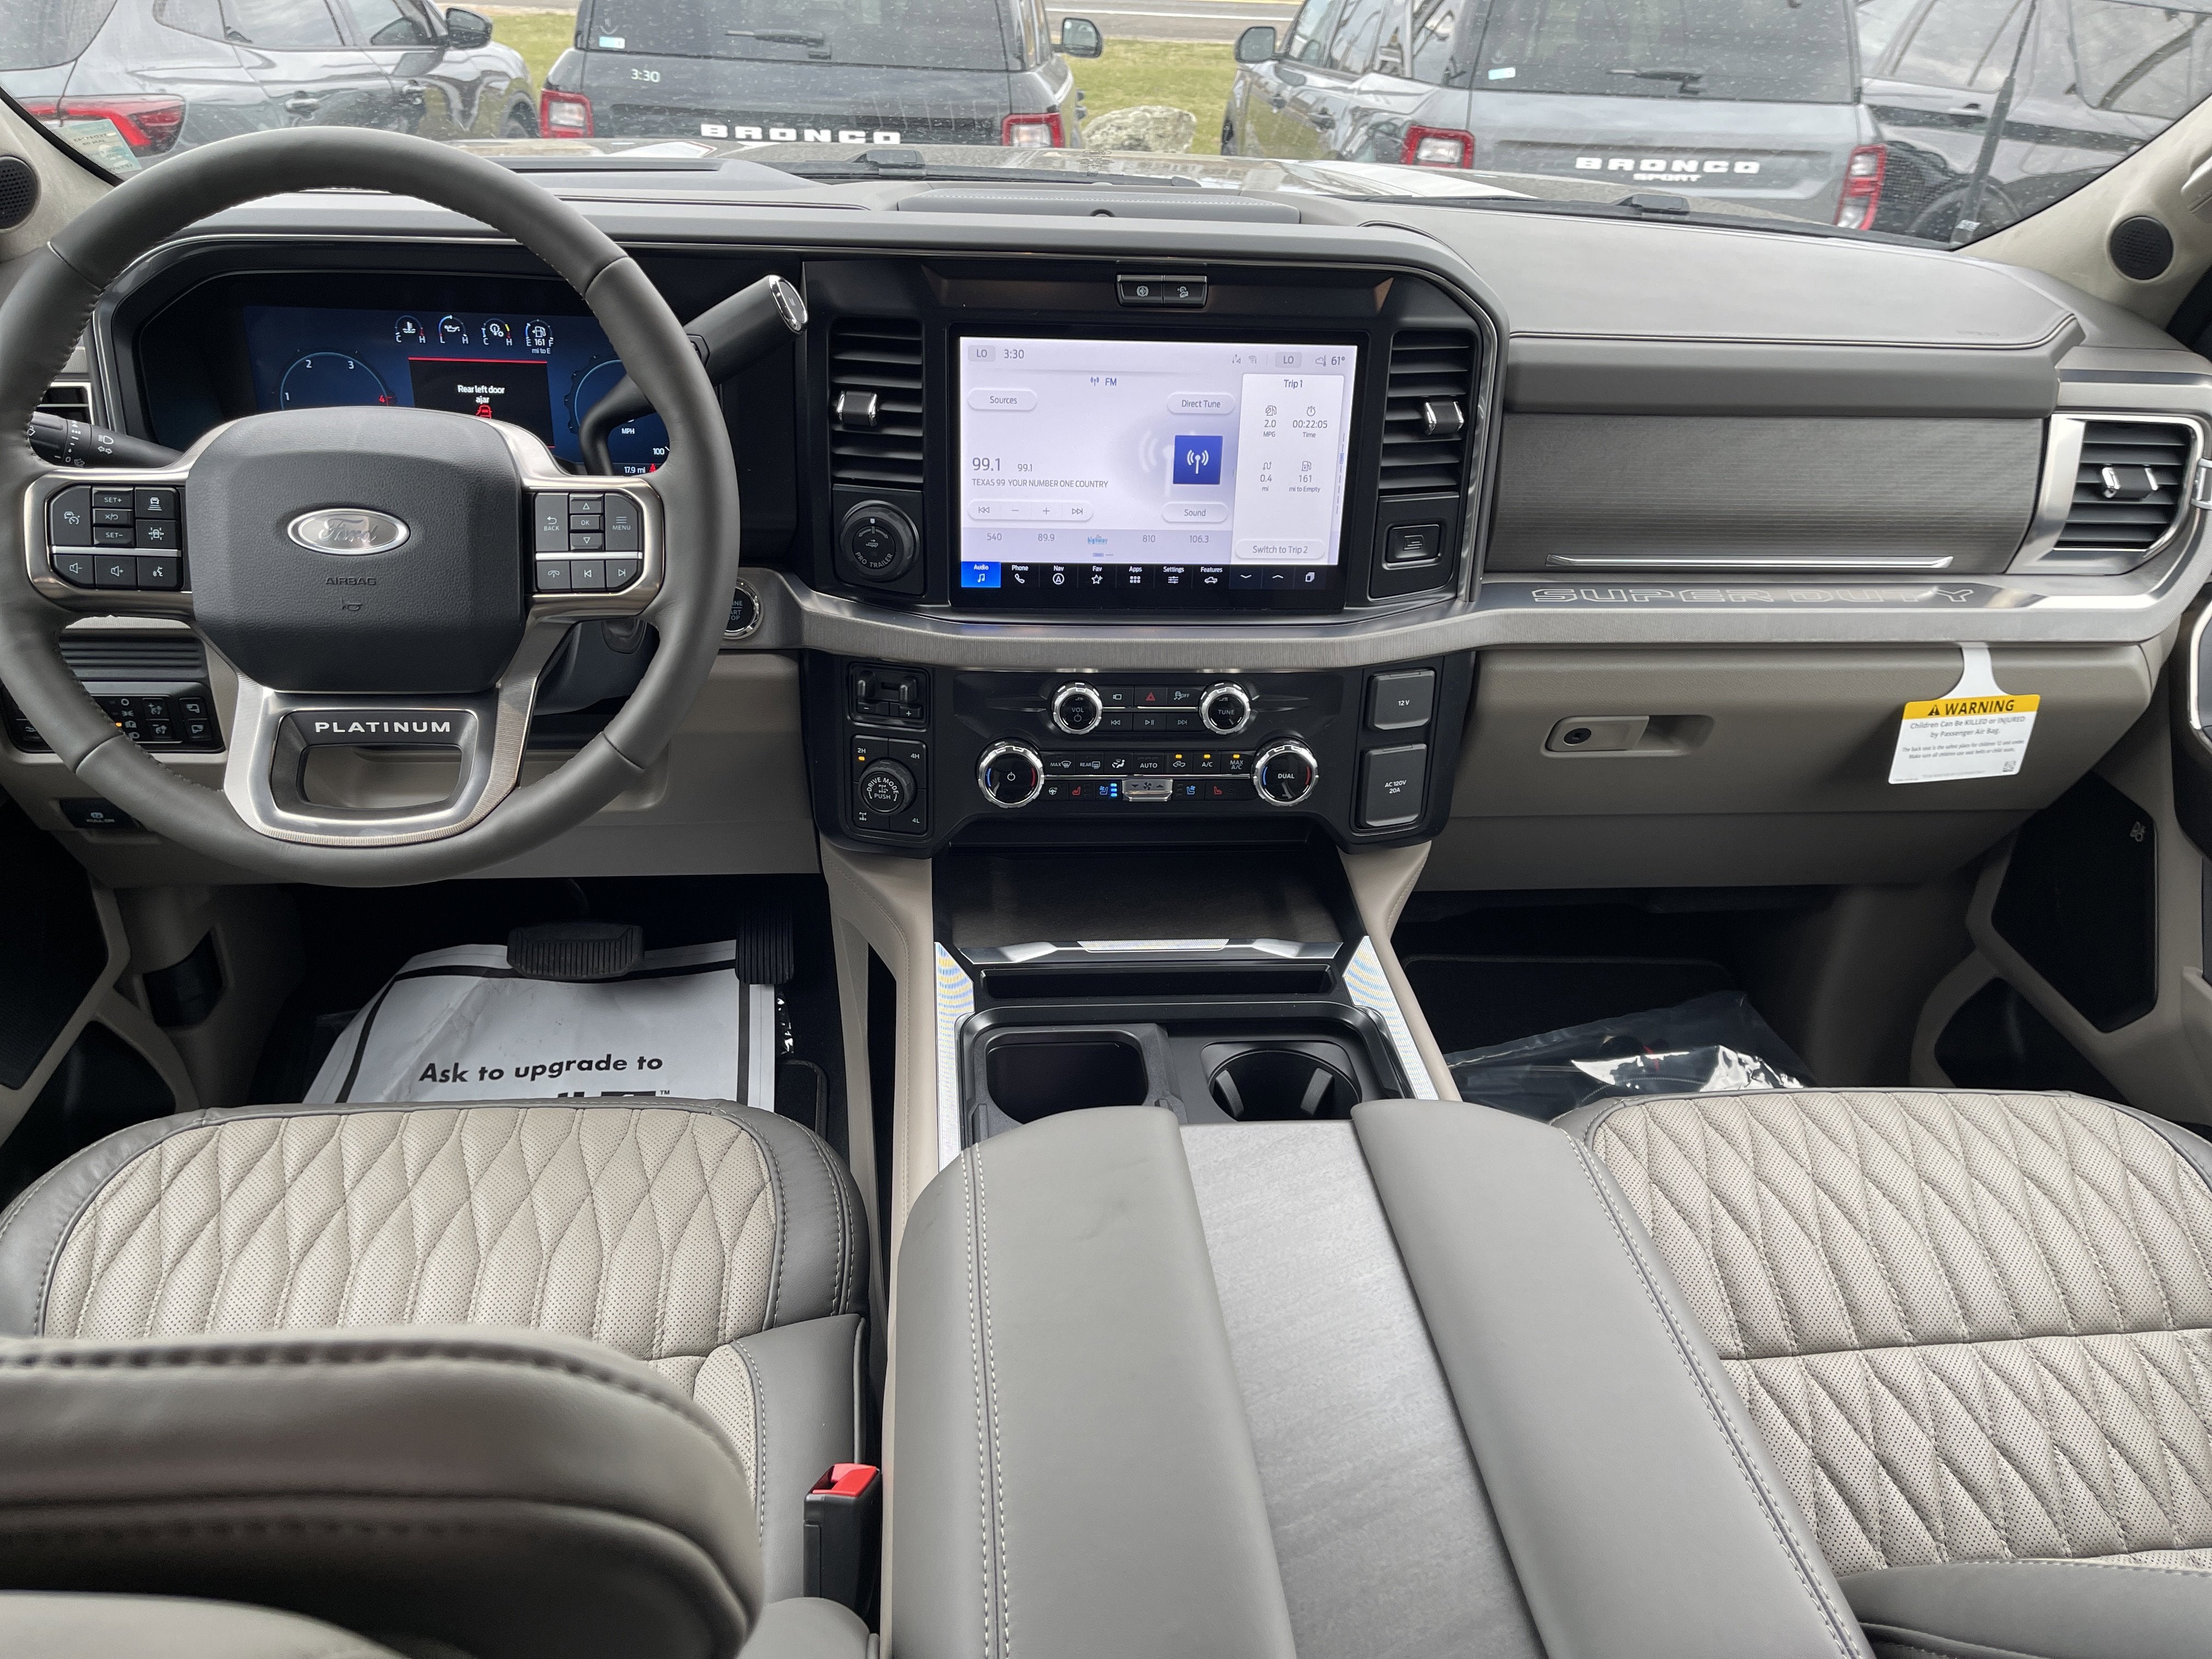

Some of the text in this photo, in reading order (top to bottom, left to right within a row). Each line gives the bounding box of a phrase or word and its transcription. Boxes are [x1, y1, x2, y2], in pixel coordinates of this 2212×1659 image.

[630, 68, 661, 83] 3:30
[700, 123, 901, 144] BRONCO
[1575, 156, 1760, 173] BRONCO
[1633, 173, 1701, 182] SPORT
[977, 349, 988, 358] LO
[1004, 349, 1024, 359] 3:30
[305, 359, 312, 369] 2
[347, 360, 354, 369] 3
[1283, 356, 1294, 365] LO
[1105, 377, 1117, 386] FM
[1284, 380, 1303, 389] Trip 1
[457, 385, 505, 394] Rear left door
[284, 392, 290, 401] 1
[475, 396, 490, 404] ajar
[989, 396, 1018, 404] Sources
[1181, 399, 1221, 409] Direct Tune
[1264, 420, 1277, 428] 2.0
[1292, 420, 1328, 428] 00:22:05
[972, 457, 1001, 471] 99.1
[1017, 464, 1033, 472] 99.1
[972, 478, 995, 487] TEXAS
[1008, 479, 1028, 487] YOUR
[1029, 479, 1058, 488] NUMBER
[1075, 480, 1109, 488] COUNTRY
[1260, 475, 1272, 483] 0.4
[1299, 475, 1312, 483] 161
[1184, 508, 1206, 517] Sound
[318, 518, 379, 543] Ford
[986, 533, 1002, 541] 540
[1037, 533, 1055, 542] 89.9
[1142, 534, 1156, 543] 810
[1189, 535, 1210, 544] 106.3
[1252, 546, 1278, 554] Switch
[1288, 546, 1302, 555] Trip
[855, 552, 893, 568] PRO TRAILER
[325, 577, 377, 585] AIRBAG
[1532, 588, 1974, 603] SUPER DUTY
[1945, 699, 2015, 715] WARNING
[315, 721, 451, 733] PLATINUM
[866, 777, 899, 794] DRIVE MODE
[419, 1053, 663, 1083] Ask to upgrade to
